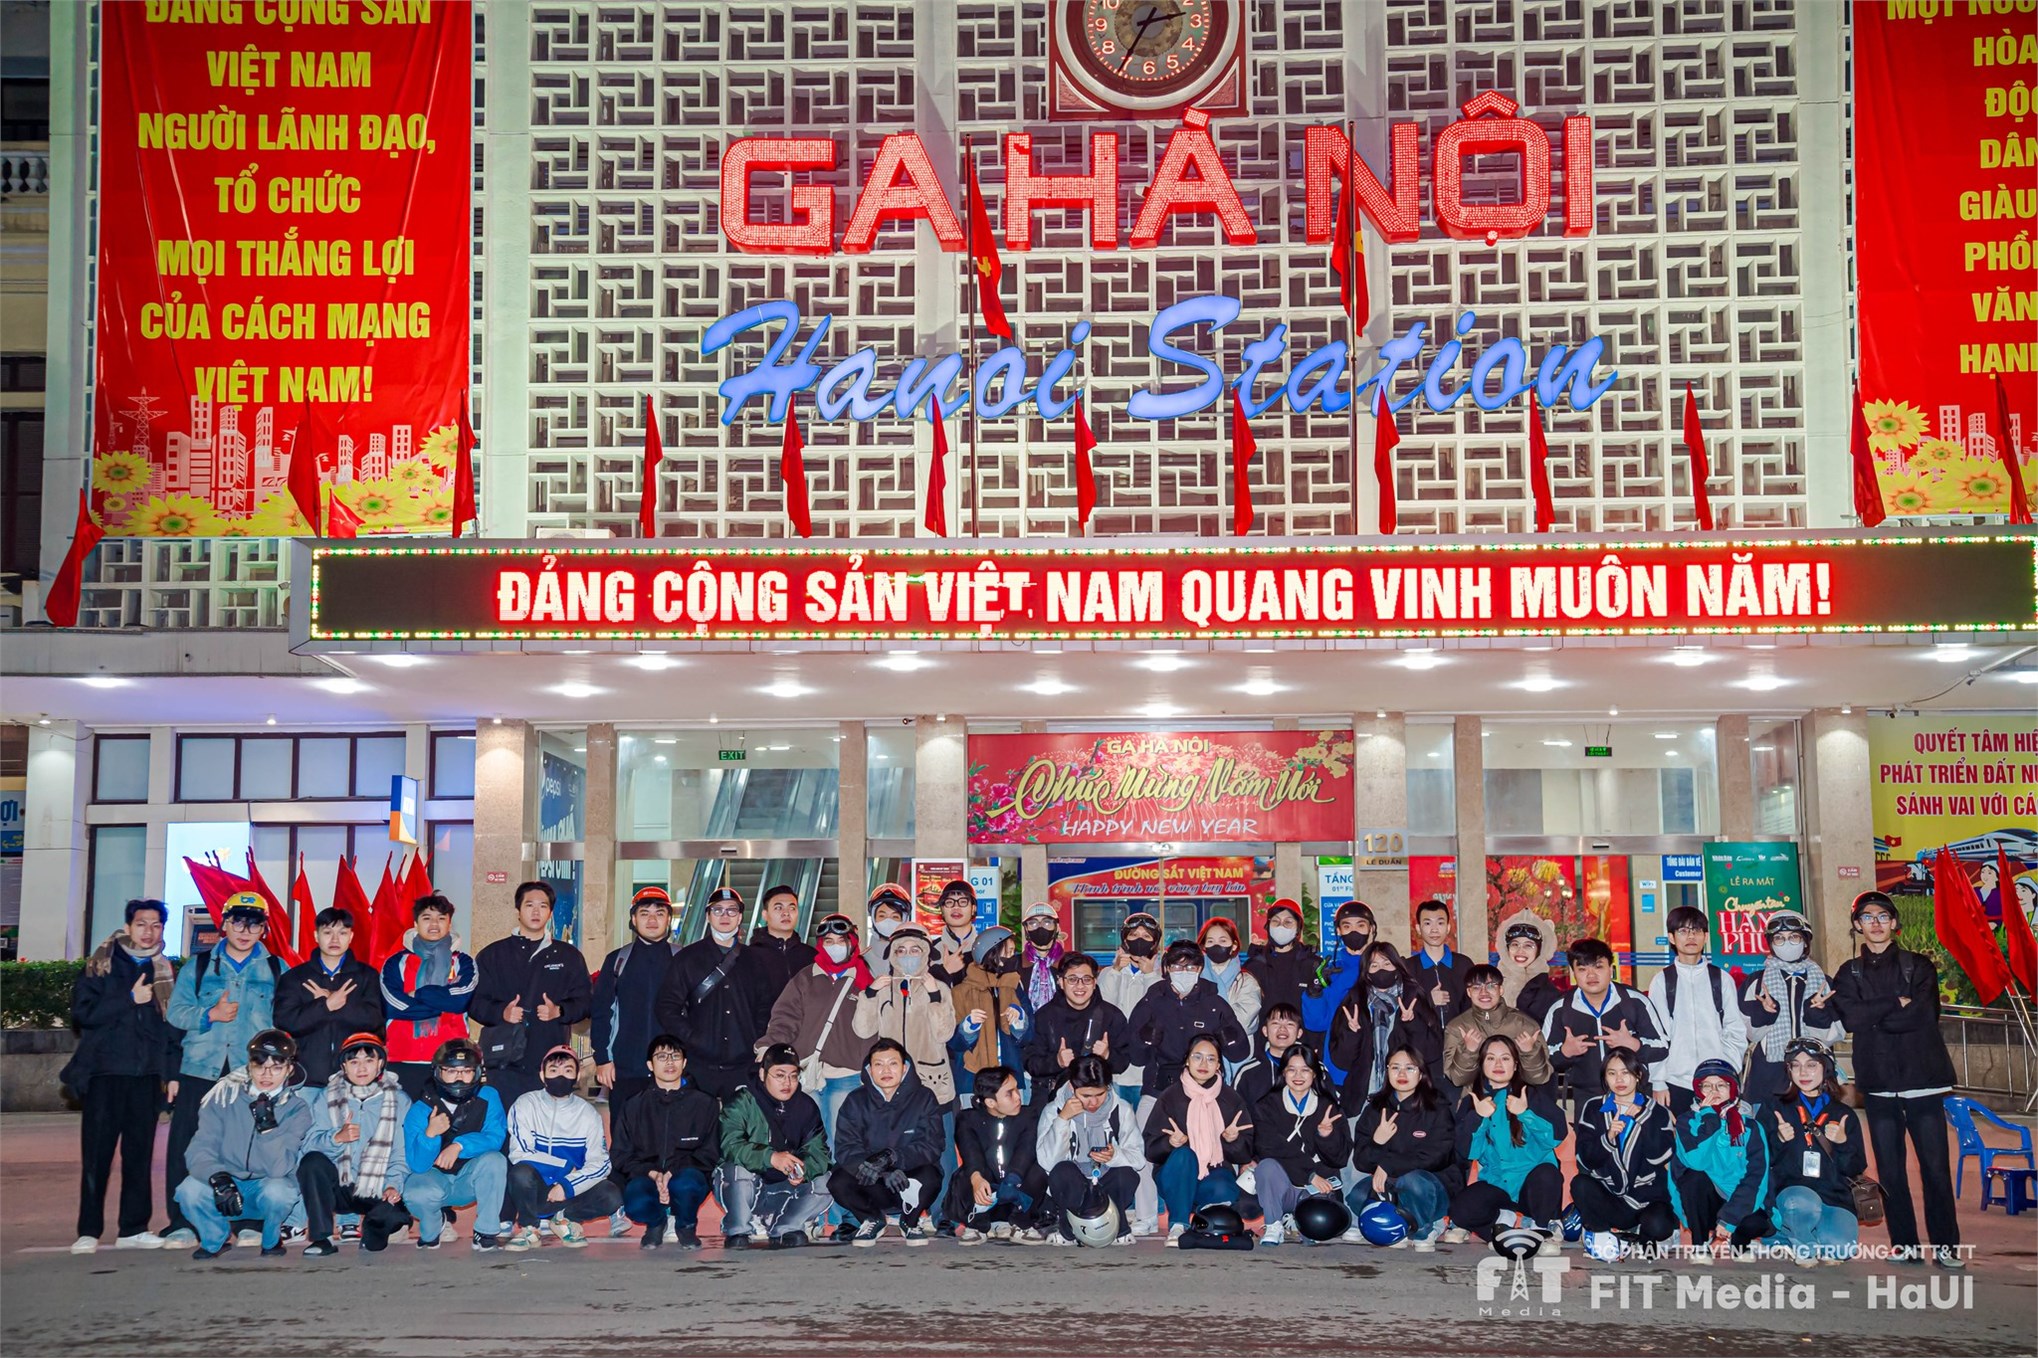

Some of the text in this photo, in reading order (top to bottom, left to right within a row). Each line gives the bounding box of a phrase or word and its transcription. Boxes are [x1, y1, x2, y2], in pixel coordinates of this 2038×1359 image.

[1095, 18, 1107, 32] 9
[1190, 14, 1202, 28] 3
[1102, 40, 1115, 54] 8
[1181, 37, 1195, 51] 4
[207, 44, 371, 96] VIỆT NAM
[1142, 61, 1155, 75] 6
[1166, 55, 1179, 69] 5
[138, 105, 436, 158] NGƯỜI LÃNH ĐẠO,
[718, 89, 1594, 255] GA HÀ NỘI
[214, 163, 361, 214] TỔ CHỨC
[1959, 184, 2037, 221] GIÀU
[158, 226, 414, 284] MỌI THẮNG LỢI
[1964, 230, 2037, 272] PHỒ
[1971, 285, 2037, 322] VĂN
[140, 291, 431, 347] CỦA CÁCH MẠNG
[700, 295, 1620, 428] Hanoi Station
[195, 359, 373, 411] VIỆT NAM!
[497, 553, 1831, 636] ĐẢNG CỘNG SẢN VIỆT NAM QUANG VINH MUÔN NĂM!
[1107, 739, 1137, 754] GA
[1172, 735, 1210, 757] NỘI
[1914, 727, 1967, 754] QUYẾT
[1971, 729, 2009, 752] TÂM
[720, 751, 745, 760] EXIT
[1880, 761, 1923, 783] PHÁT
[1929, 757, 1978, 784] TRIỂN
[1983, 758, 2015, 783] ĐẤT
[1896, 792, 1943, 816] SÁNH
[1948, 796, 1975, 816] VAI
[1980, 792, 2008, 816] VỚI
[1061, 818, 1258, 837] HAPPY NEW YEAR
[1363, 832, 1403, 853] 120
[982, 877, 993, 886] 01
[1187, 865, 1212, 881] VIỆT
[1213, 867, 1244, 879] NAM
